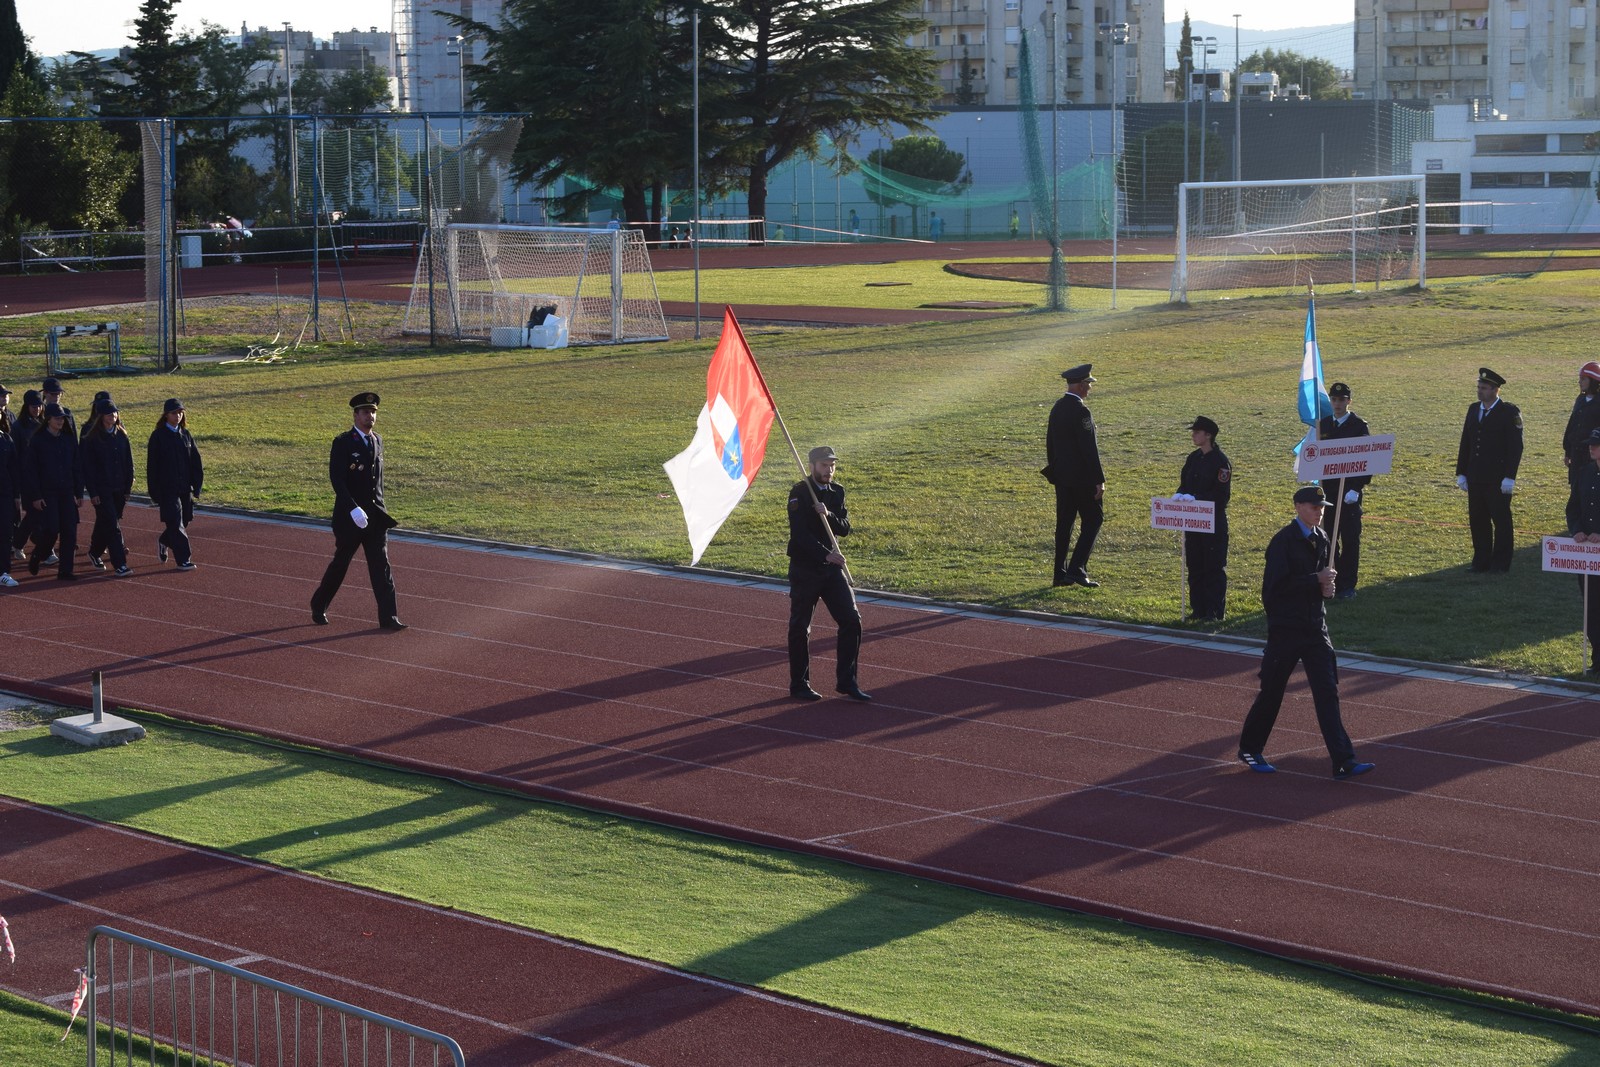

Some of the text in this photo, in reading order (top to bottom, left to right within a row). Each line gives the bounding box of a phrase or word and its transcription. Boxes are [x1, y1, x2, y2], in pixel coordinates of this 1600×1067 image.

[1320, 442, 1392, 456] VATROGASNA ZAJEDNICA ŽUPANIJE
[1185, 519, 1211, 529] PODRAVSKE
[1560, 544, 1585, 553] VATROGASNA
